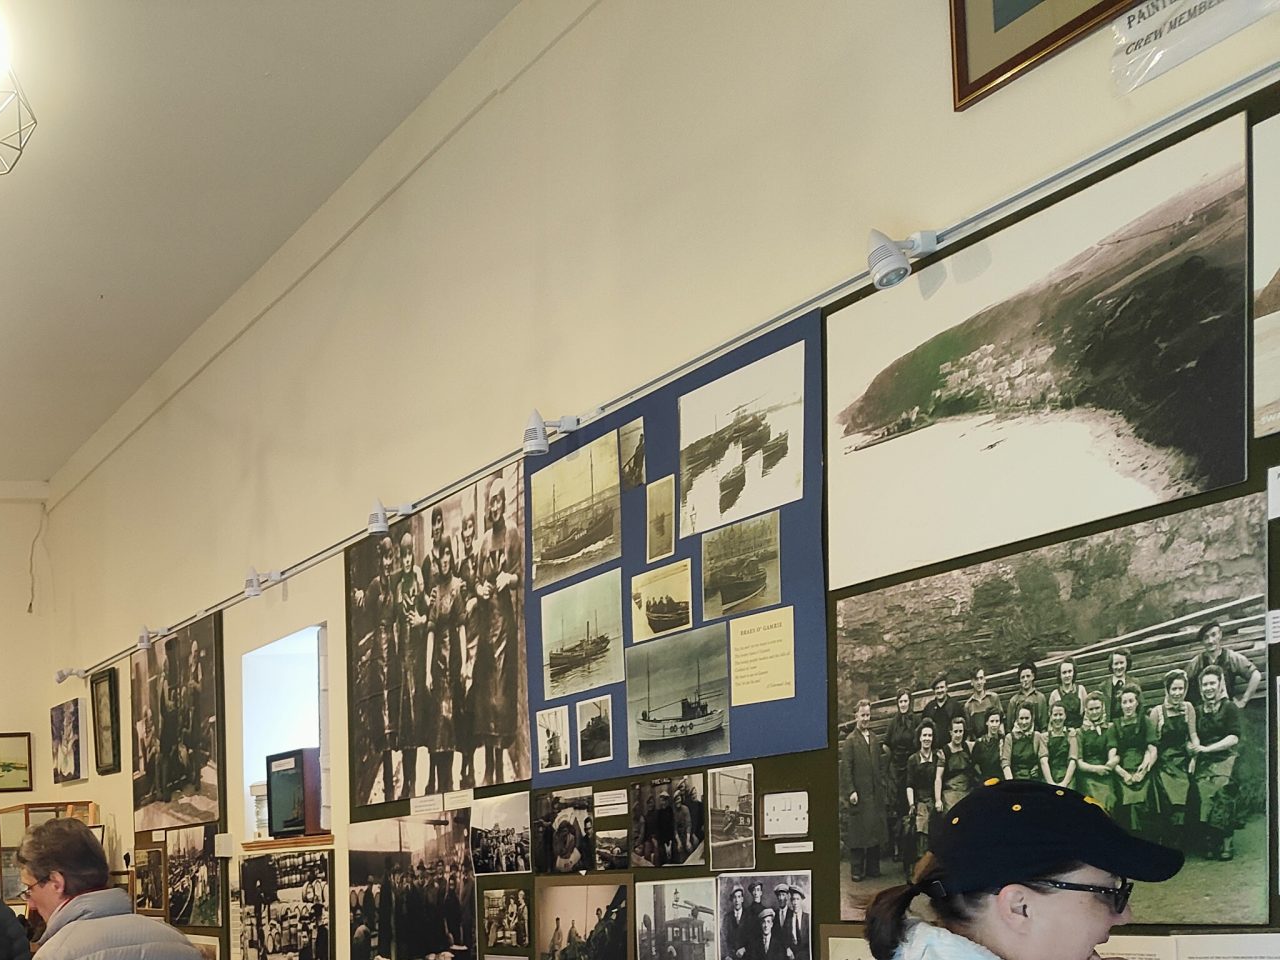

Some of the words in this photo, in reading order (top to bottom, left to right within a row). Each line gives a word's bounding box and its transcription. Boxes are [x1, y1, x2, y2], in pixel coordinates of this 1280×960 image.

[1126, 28, 1163, 55] CREW
[1166, 0, 1222, 34] MEMBE
[741, 628, 755, 636] BRAES
[763, 622, 782, 631] GAMRIE
